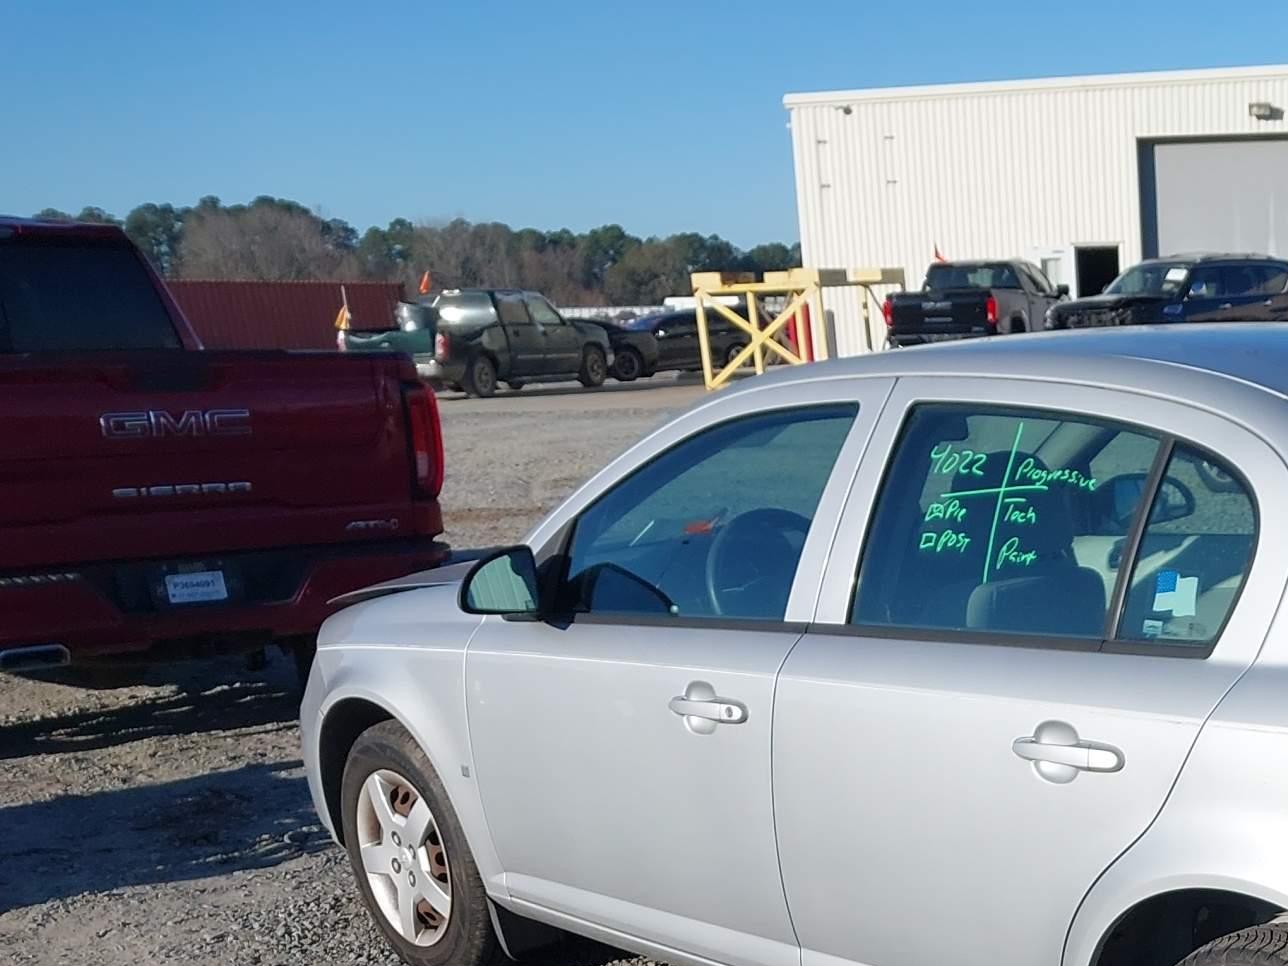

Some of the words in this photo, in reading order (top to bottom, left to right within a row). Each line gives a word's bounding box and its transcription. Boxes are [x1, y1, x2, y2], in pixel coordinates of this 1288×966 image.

[100, 409, 252, 438] GMC
[930, 444, 987, 475] 4022
[1015, 458, 1098, 491] Progressive
[113, 481, 253, 497] SIERRA
